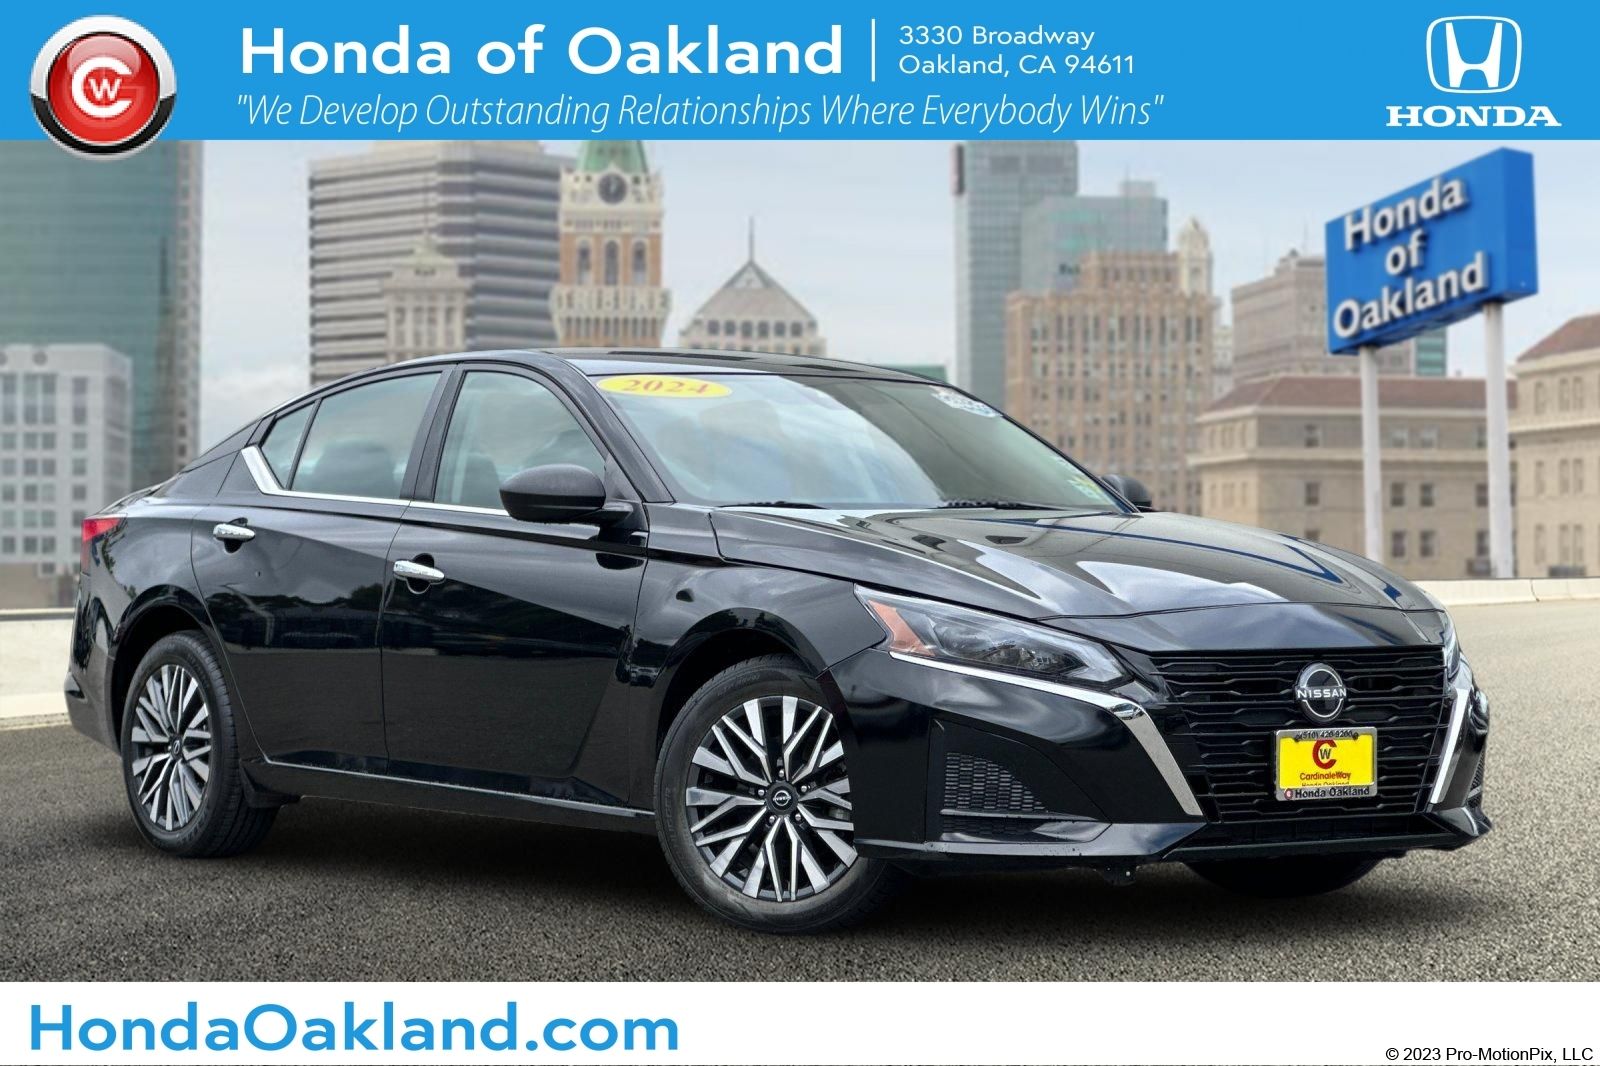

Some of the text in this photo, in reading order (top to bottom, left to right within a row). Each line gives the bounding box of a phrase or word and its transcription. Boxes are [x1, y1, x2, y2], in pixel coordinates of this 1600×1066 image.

[1344, 175, 1466, 251] Honda
[1384, 228, 1427, 276] of
[1333, 251, 1489, 338] Oakland
[621, 380, 709, 394] 2024
[1297, 688, 1347, 698] NISSAN
[1300, 771, 1352, 781] CardinaleWay
[1295, 786, 1370, 798] Honda Oakland
